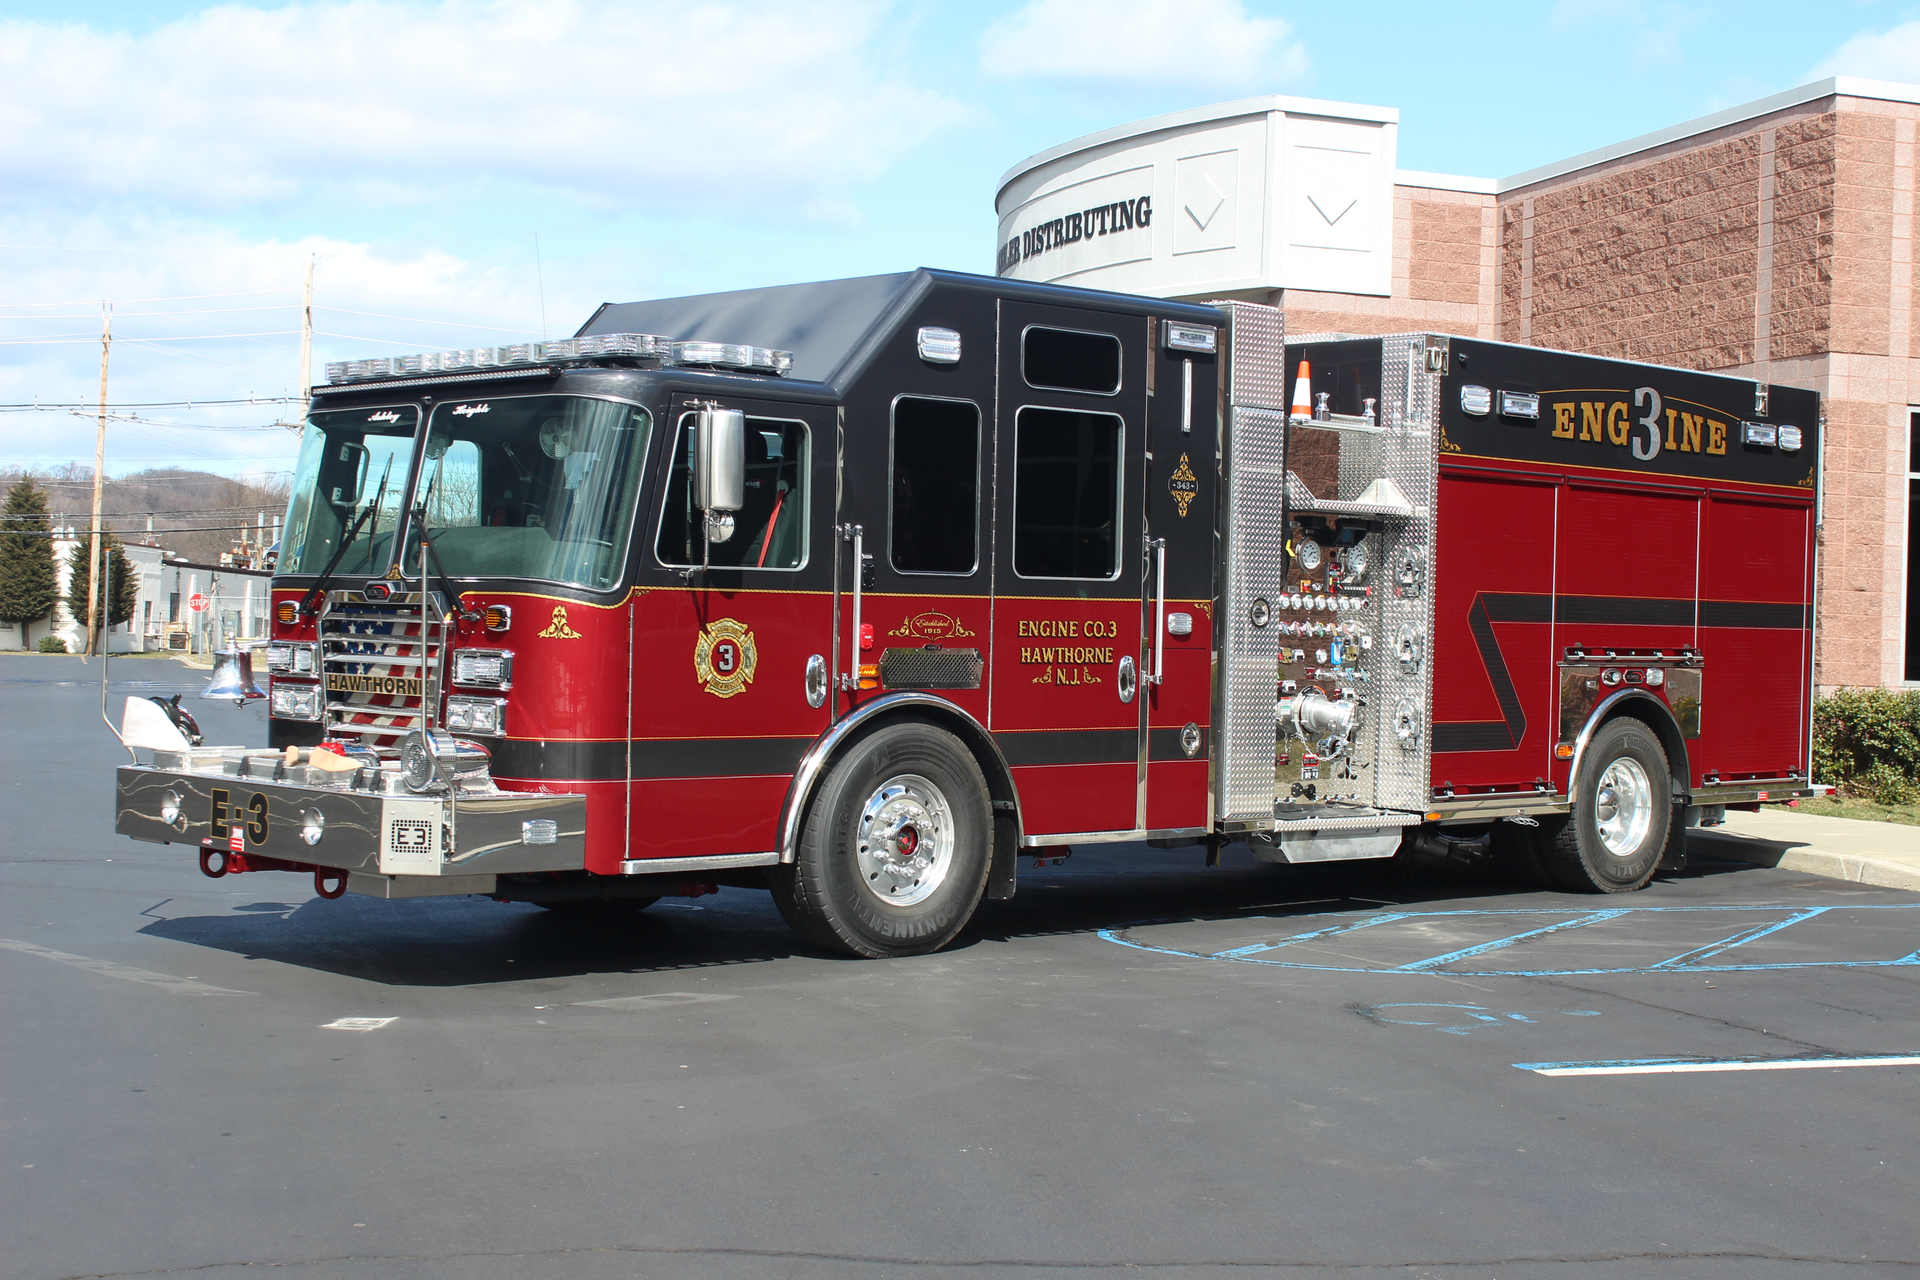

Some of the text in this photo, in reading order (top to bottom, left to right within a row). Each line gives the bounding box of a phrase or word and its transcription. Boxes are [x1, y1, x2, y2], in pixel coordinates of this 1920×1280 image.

[1023, 196, 1152, 260] DISTRIBUTING
[367, 411, 401, 424] Ashley
[452, 403, 491, 418] Heights
[1176, 481, 1190, 490] 343
[190, 599, 208, 607] STOP
[1018, 620, 1079, 638] ENGINE
[717, 644, 734, 672] 3
[1020, 646, 1114, 665] HAWTHORNE
[1056, 668, 1081, 686] N.J.
